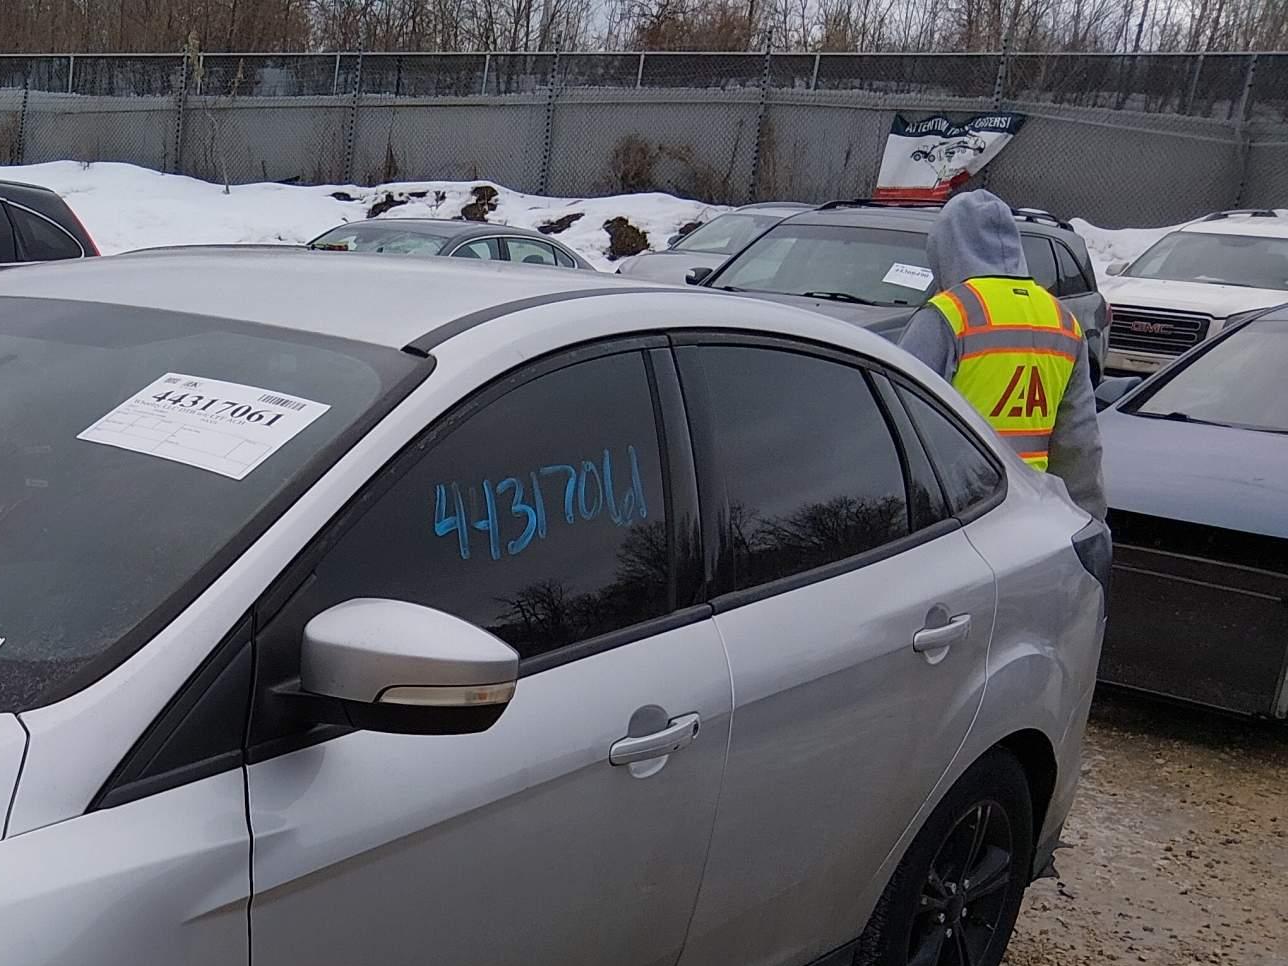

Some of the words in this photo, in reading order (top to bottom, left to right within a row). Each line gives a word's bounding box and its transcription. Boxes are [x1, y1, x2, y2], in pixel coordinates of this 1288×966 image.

[1131, 321, 1175, 334] GMC
[152, 390, 284, 427] 44317061
[433, 444, 648, 560] 44317061
